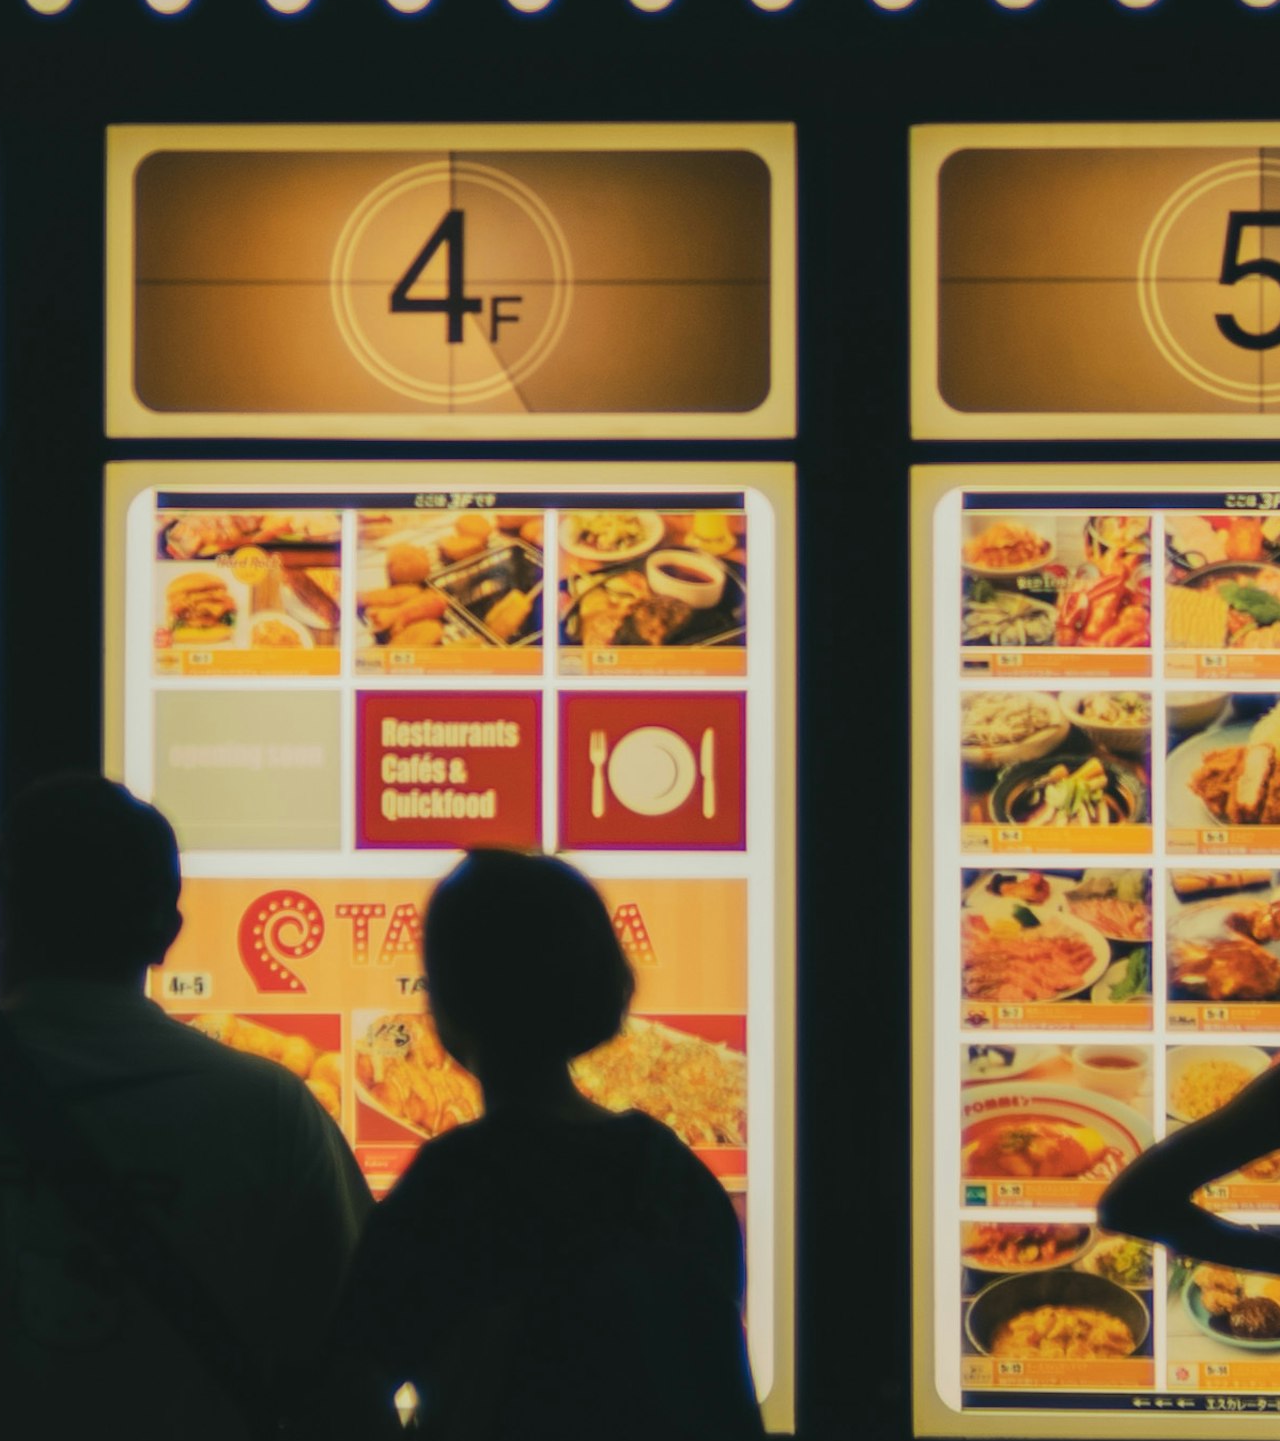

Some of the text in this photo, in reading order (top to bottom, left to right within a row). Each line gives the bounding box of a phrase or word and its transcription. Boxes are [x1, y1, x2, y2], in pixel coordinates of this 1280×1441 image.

[387, 208, 524, 344] 4F
[380, 717, 520, 748] Restaurants
[380, 751, 467, 784] Cafés &
[380, 787, 496, 821] Quickfood
